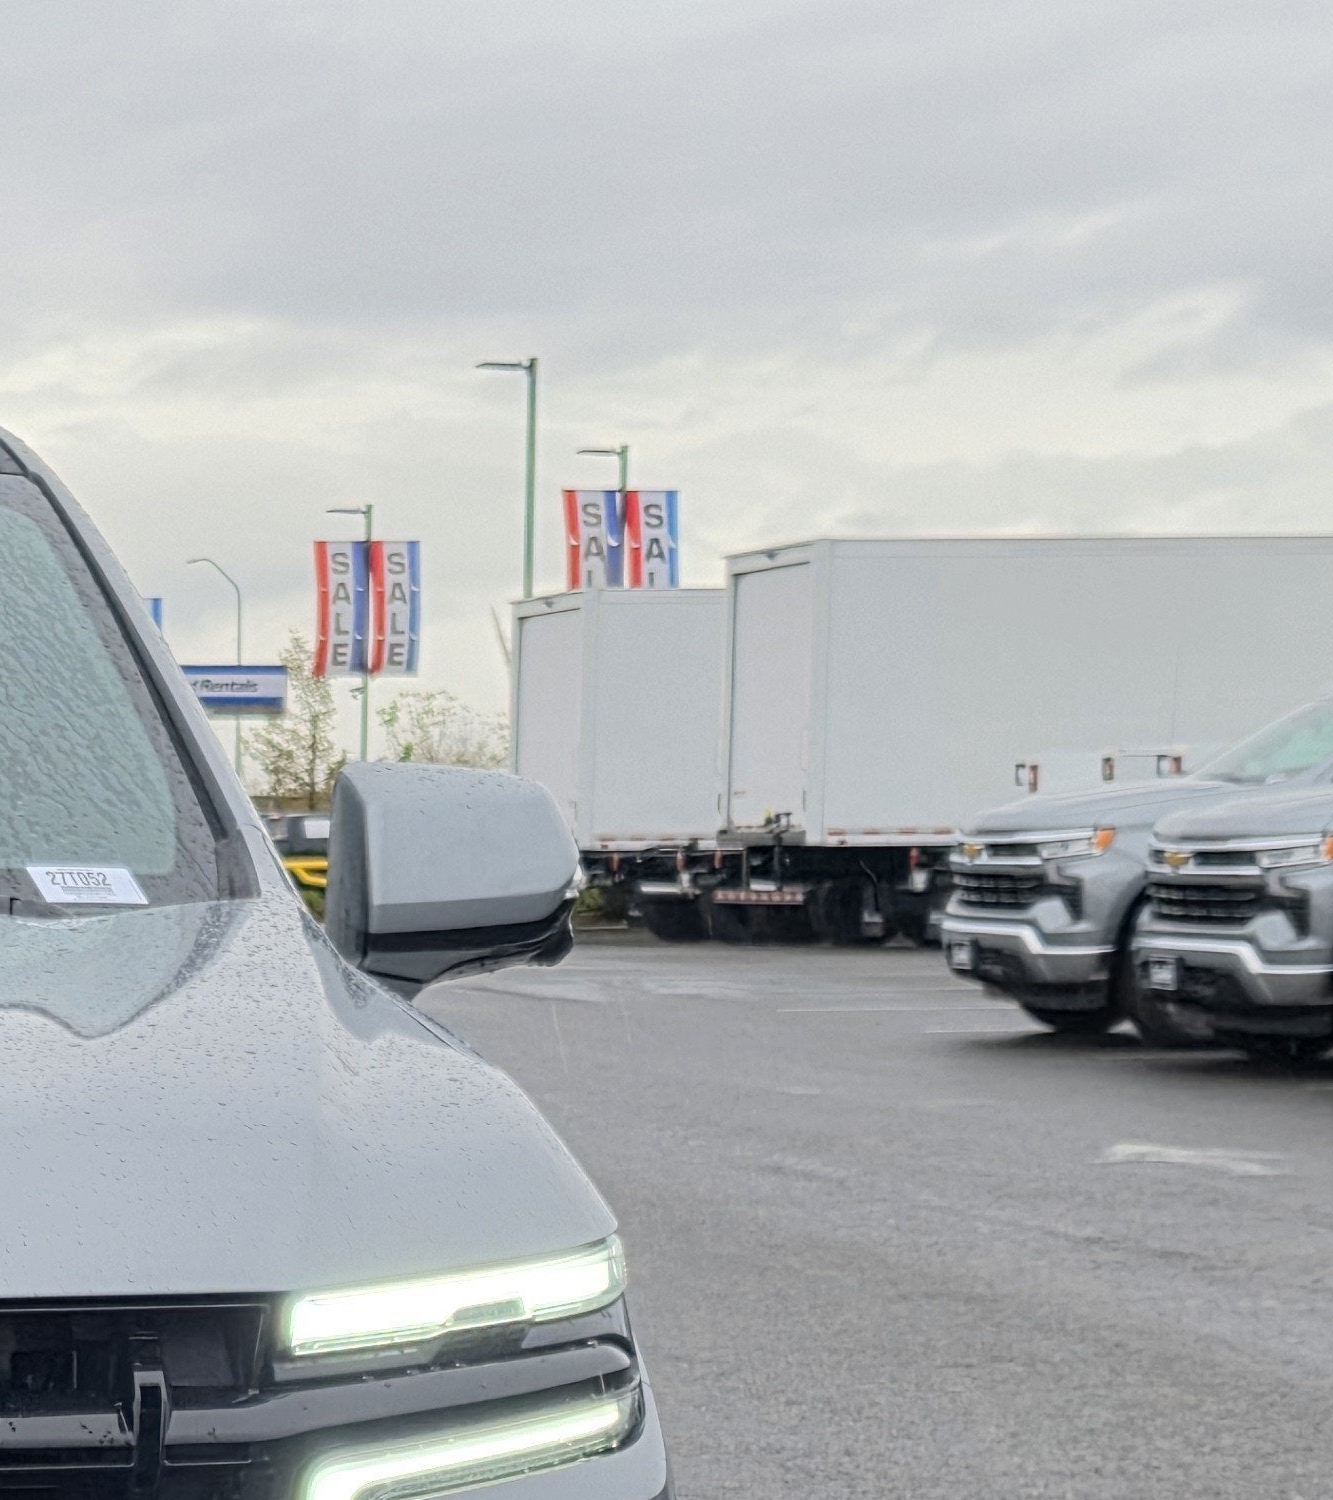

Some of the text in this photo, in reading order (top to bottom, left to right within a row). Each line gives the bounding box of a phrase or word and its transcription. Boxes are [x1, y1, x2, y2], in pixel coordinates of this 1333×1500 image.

[582, 503, 606, 588] SA
[644, 504, 666, 588] SA
[331, 552, 351, 667] SALE
[387, 552, 407, 667] SALE
